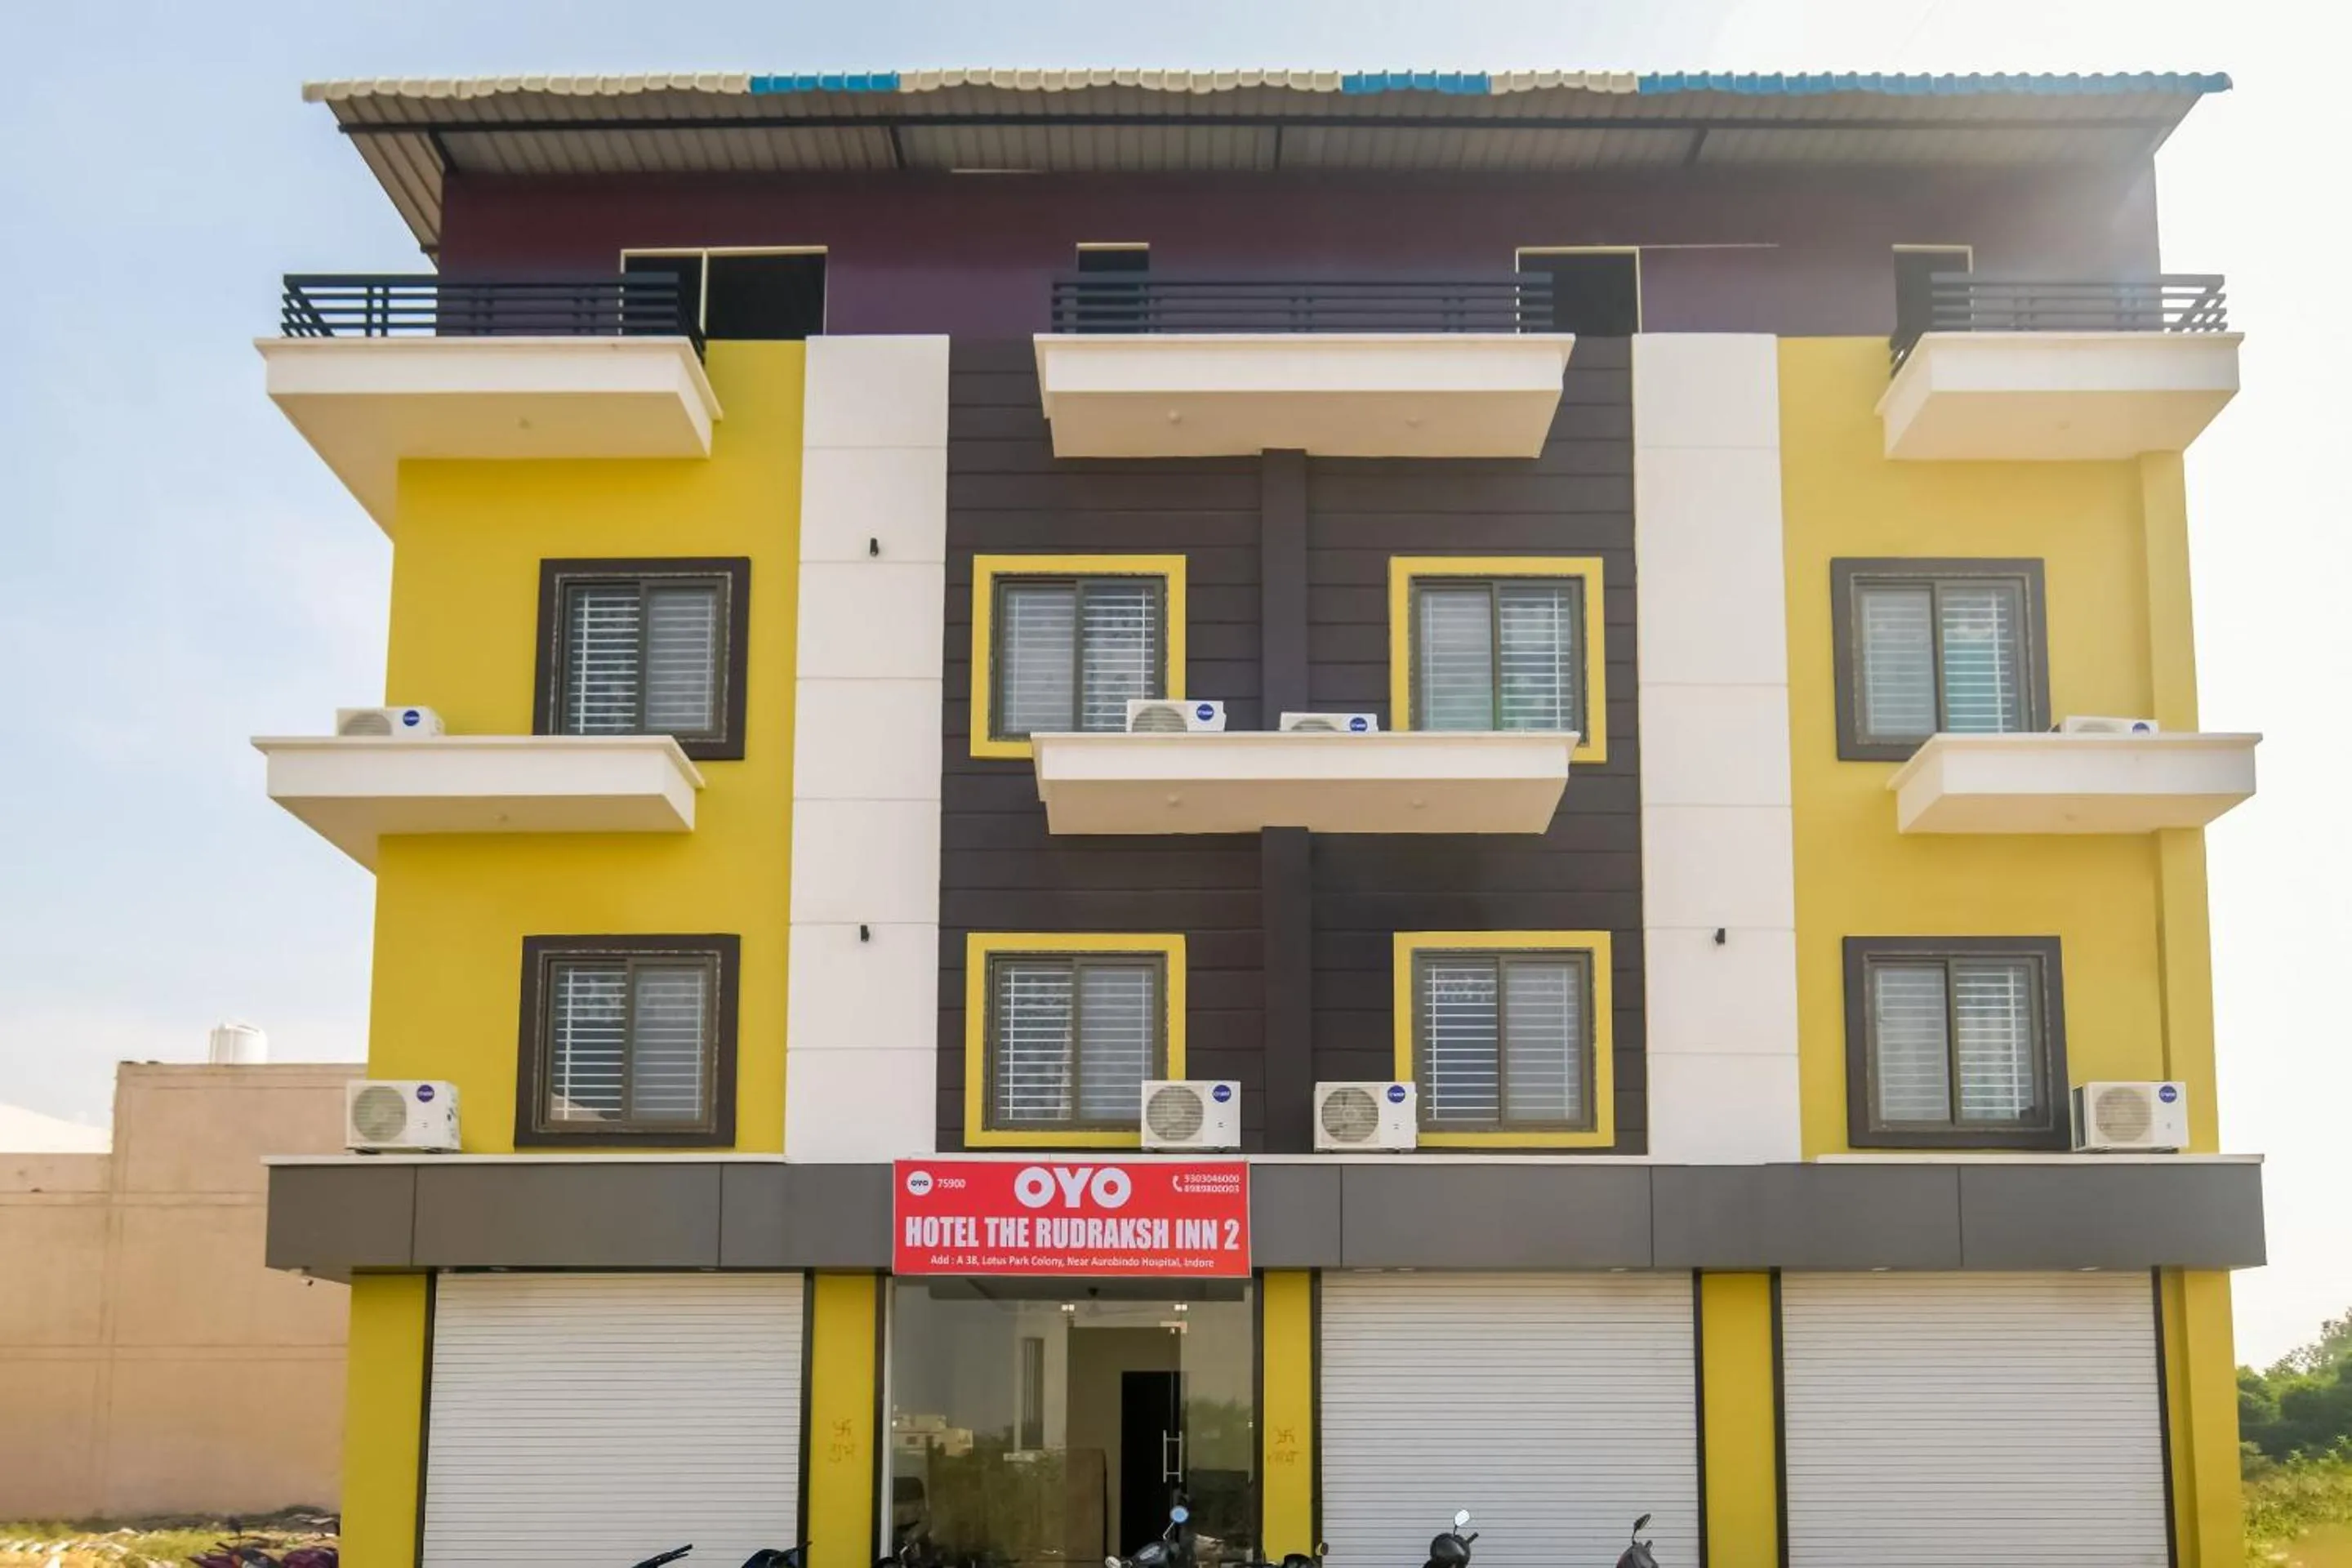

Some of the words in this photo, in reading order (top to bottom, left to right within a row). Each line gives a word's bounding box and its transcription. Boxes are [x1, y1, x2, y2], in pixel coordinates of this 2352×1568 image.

[937, 1178, 966, 1189] 75900
[1014, 1166, 1132, 1208] OYO
[905, 1216, 979, 1248] HOTEL
[984, 1217, 1029, 1248] THE
[1036, 1218, 1169, 1250] RUDRAKSH
[1176, 1219, 1218, 1250] INN
[1224, 1219, 1240, 1250] 2
[931, 1255, 949, 1264] Add
[956, 1256, 964, 1264] A
[982, 1256, 1006, 1265] Lotus
[1009, 1255, 1029, 1265] Park
[1031, 1256, 1064, 1267] Colony,
[1067, 1256, 1089, 1266] Near
[1091, 1256, 1140, 1266] Aurobindo
[1184, 1258, 1214, 1267] Indore
